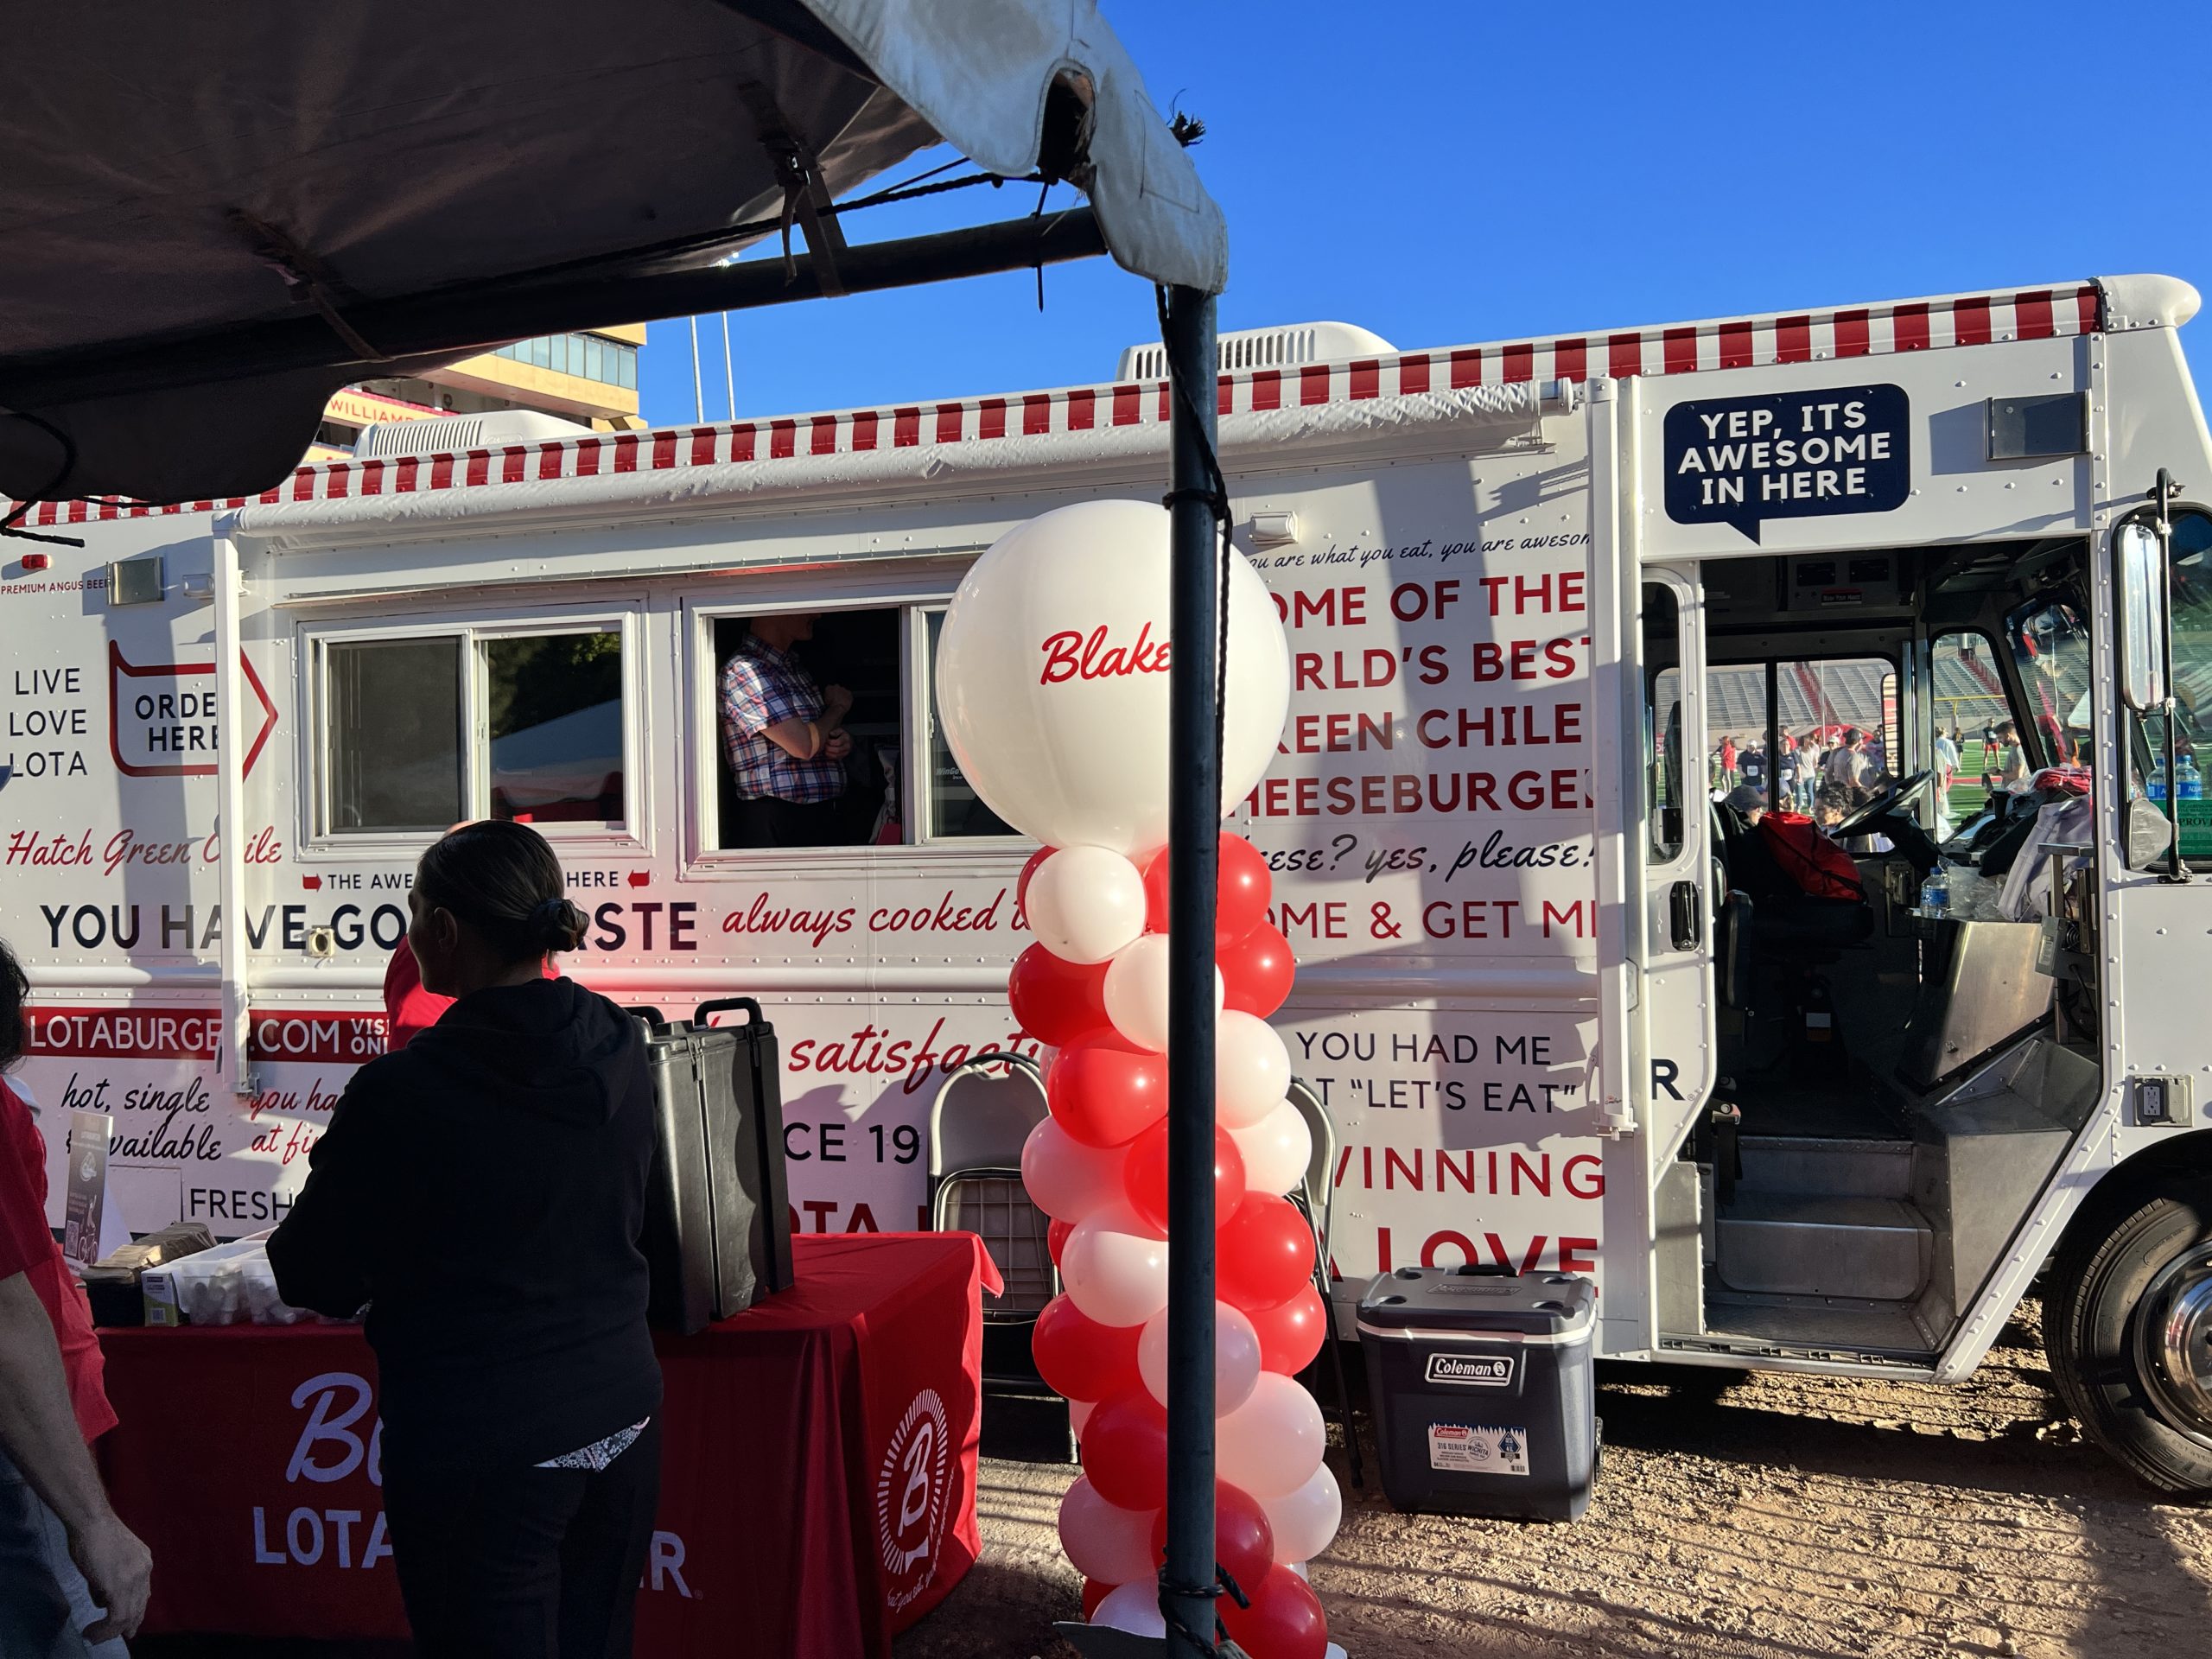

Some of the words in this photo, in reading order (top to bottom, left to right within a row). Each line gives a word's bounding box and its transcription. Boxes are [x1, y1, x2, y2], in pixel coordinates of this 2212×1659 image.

[1700, 409, 1782, 440] YEP,
[1802, 401, 1866, 431] ITS
[1678, 432, 1891, 474] AWESOME
[1702, 477, 1744, 505] IN
[1763, 467, 1866, 501] HERE
[1250, 556, 1268, 569] ou
[1274, 554, 1305, 568] are
[1311, 544, 1357, 566] what
[1360, 546, 1394, 569] you
[1400, 539, 1433, 559] eat,
[1441, 541, 1476, 563] you
[1482, 537, 1514, 552] are
[1, 583, 46, 594] PREMIUM
[49, 581, 84, 591] ANGUS
[1390, 580, 1460, 622] OF
[1480, 571, 1585, 616] THE
[1040, 621, 1173, 685] Blake
[1296, 645, 1450, 691] RLD’S
[1473, 637, 1591, 683] BES
[16, 668, 81, 696] LIVE
[10, 709, 87, 736] LOVE
[135, 692, 216, 720] ORDE
[1277, 712, 1393, 754] EEN
[1417, 703, 1581, 749] CHILE
[10, 751, 88, 777] LOTA
[7, 829, 92, 867] Hatch
[104, 829, 191, 876] Green
[203, 826, 283, 865] Cile
[1365, 845, 1438, 884] yes,
[327, 874, 362, 889] THE
[371, 874, 413, 889] AWE
[566, 871, 620, 888] HERE
[40, 904, 140, 950] YOU
[162, 904, 307, 950] HAVE
[330, 904, 408, 950] GO
[578, 902, 697, 951] STE
[721, 892, 856, 948] always
[868, 888, 1007, 932] cooked
[1370, 901, 1402, 939] &
[1422, 900, 1519, 939] GET
[30, 1014, 340, 1053] LOTABURGE.COM
[1297, 1032, 1376, 1061] YOU
[1393, 1033, 1478, 1064] HAD
[1496, 1036, 1552, 1065] ME
[788, 1017, 1039, 1095] satisfacti
[60, 1072, 111, 1112] hot,
[124, 1077, 210, 1126] single
[251, 1091, 298, 1121] you
[306, 1077, 339, 1111] ha
[110, 1123, 222, 1162] vailable
[251, 1125, 283, 1153] at
[283, 1121, 319, 1166] fi
[784, 1122, 847, 1161] CE
[868, 1124, 920, 1164] 19
[191, 1188, 293, 1221] FRESH
[1435, 1358, 1491, 1376] Coleman
[1436, 1427, 1461, 1437] Coleman
[1448, 1443, 1466, 1452] SERIES
[1468, 1446, 1489, 1456] WICHITA
[253, 1506, 394, 1569] LOTA
